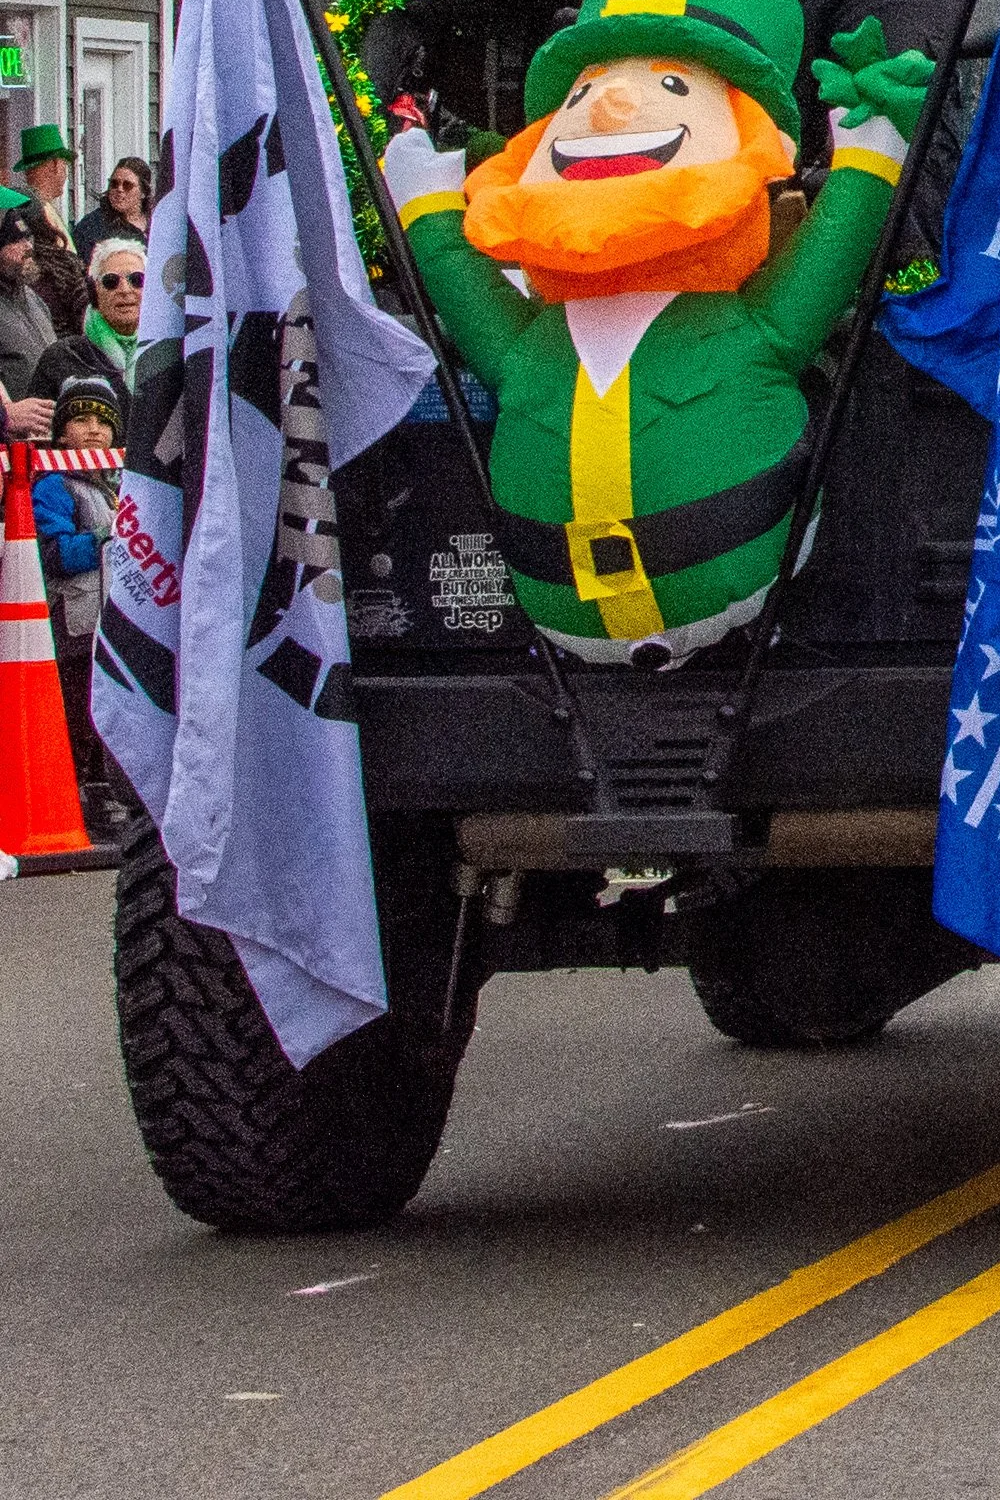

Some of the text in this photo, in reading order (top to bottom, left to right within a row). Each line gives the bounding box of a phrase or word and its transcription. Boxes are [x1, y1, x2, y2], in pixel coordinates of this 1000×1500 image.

[430, 552, 458, 569] ALL
[441, 579, 504, 596] BUT ONLY
[444, 605, 503, 632] Jeep
